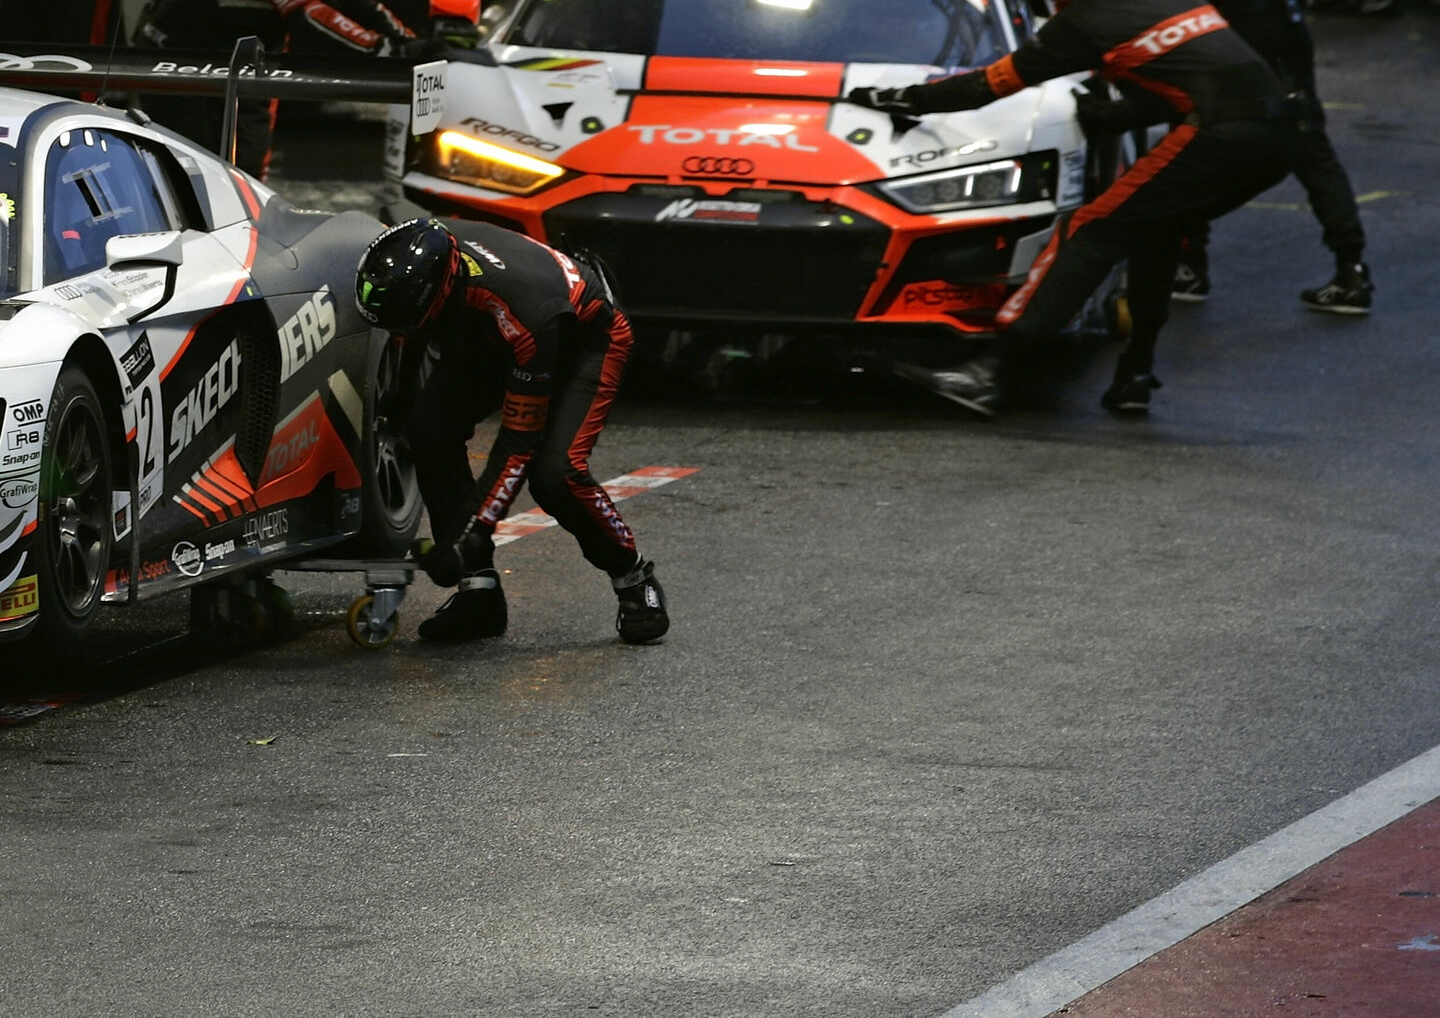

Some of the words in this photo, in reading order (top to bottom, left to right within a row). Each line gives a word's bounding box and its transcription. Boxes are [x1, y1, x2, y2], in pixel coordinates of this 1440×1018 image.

[1133, 12, 1230, 55] TOTA
[416, 73, 445, 94] TOTAL
[461, 117, 561, 153] ROFGO
[628, 124, 820, 153] TOTAL
[889, 139, 999, 168] ROFGO
[13, 403, 44, 423] OMP
[16, 430, 40, 447] R8
[266, 420, 320, 479] TOTAL
[2, 450, 41, 466] Snap-on
[0, 482, 38, 499] GrafiWrap
[140, 485, 152, 507] PRO
[479, 462, 526, 523] TOTAL
[242, 507, 289, 544] LENAERTS
[204, 538, 236, 560] Snap-on
[144, 557, 172, 580] Sport
[646, 584, 660, 610] OMP
